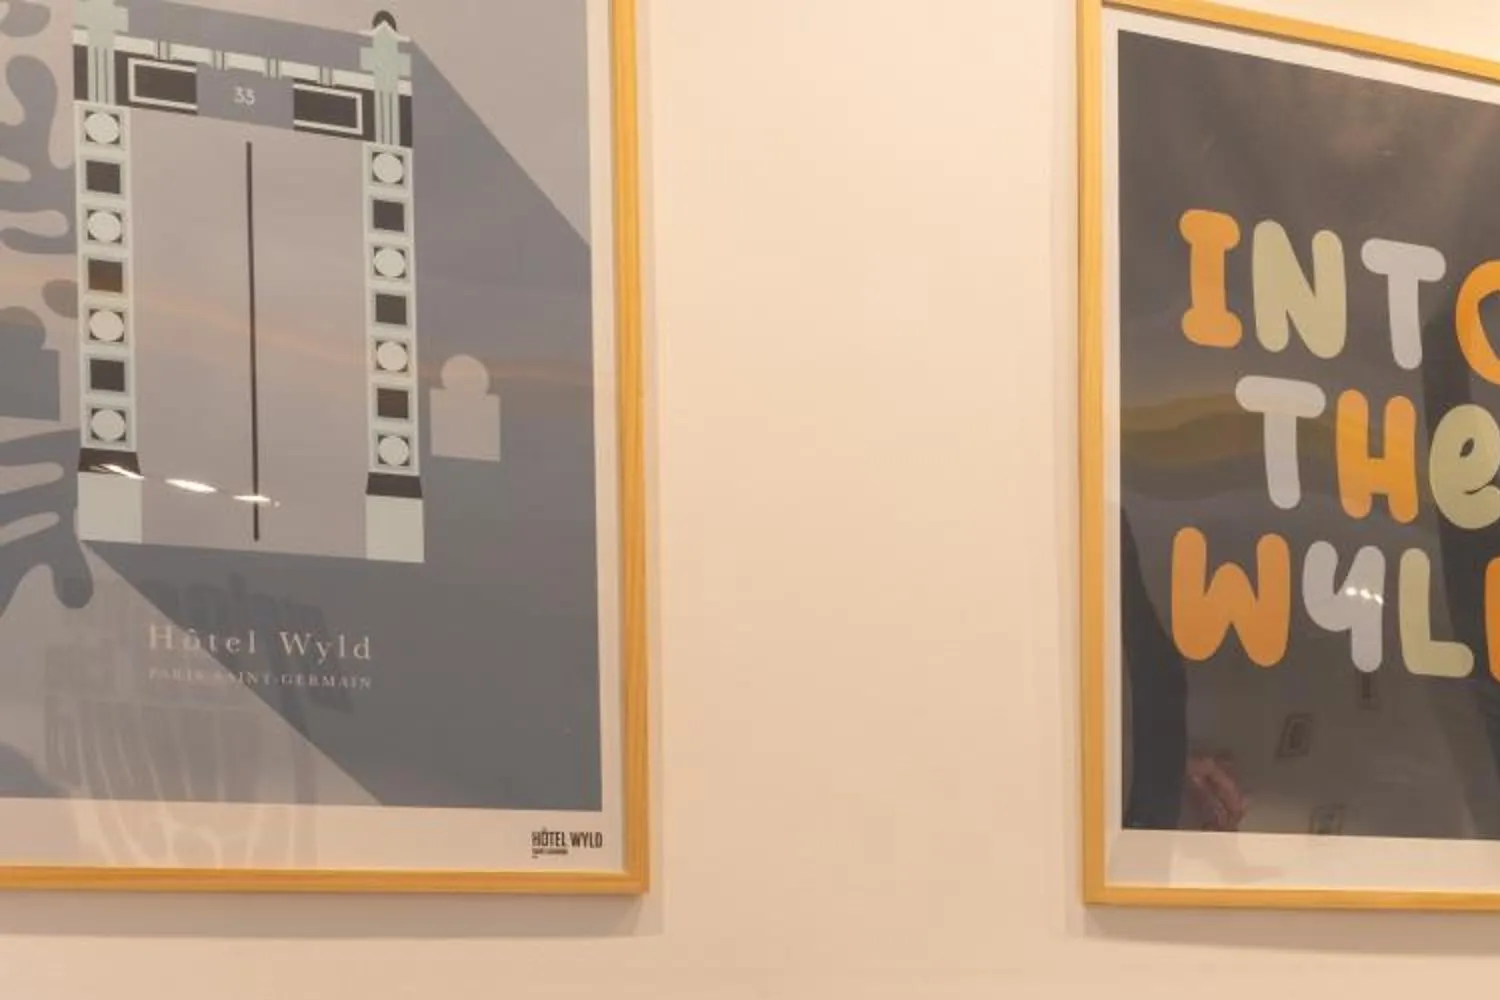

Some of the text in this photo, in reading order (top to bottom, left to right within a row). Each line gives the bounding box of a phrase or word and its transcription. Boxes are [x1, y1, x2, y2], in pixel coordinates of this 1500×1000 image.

[149, 624, 372, 666] Hôtel Wyld
[569, 831, 603, 848] WYLD
